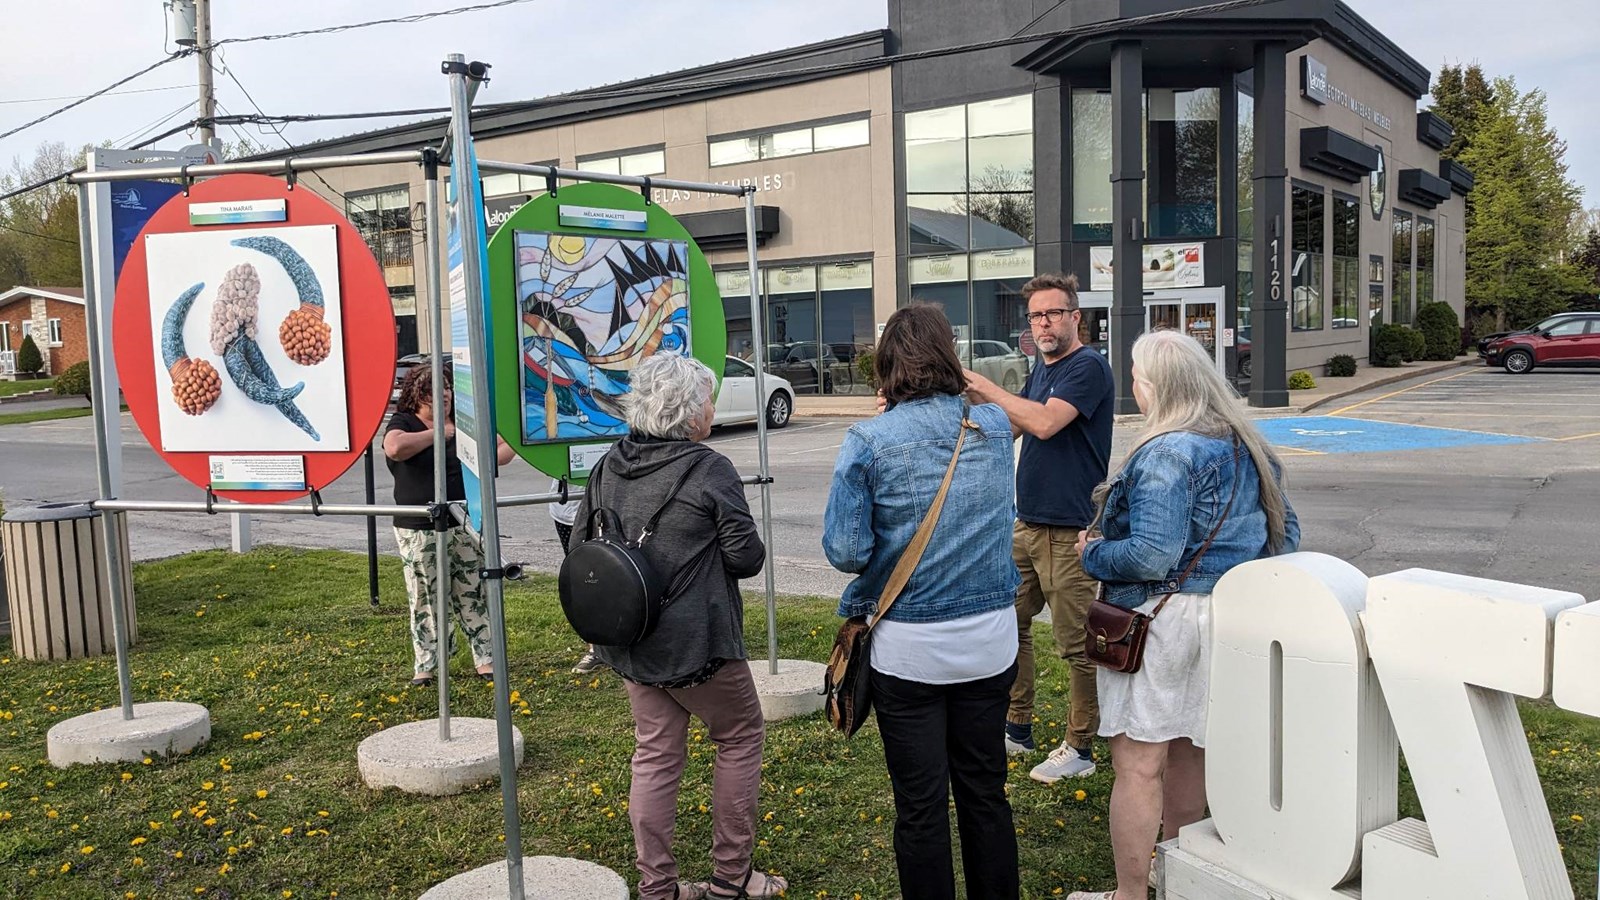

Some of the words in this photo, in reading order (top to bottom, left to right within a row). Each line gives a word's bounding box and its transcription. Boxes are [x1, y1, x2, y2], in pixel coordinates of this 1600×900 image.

[653, 188, 691, 204] ELAS
[583, 210, 605, 219] MÉLANIE
[1270, 239, 1281, 301] 1120
